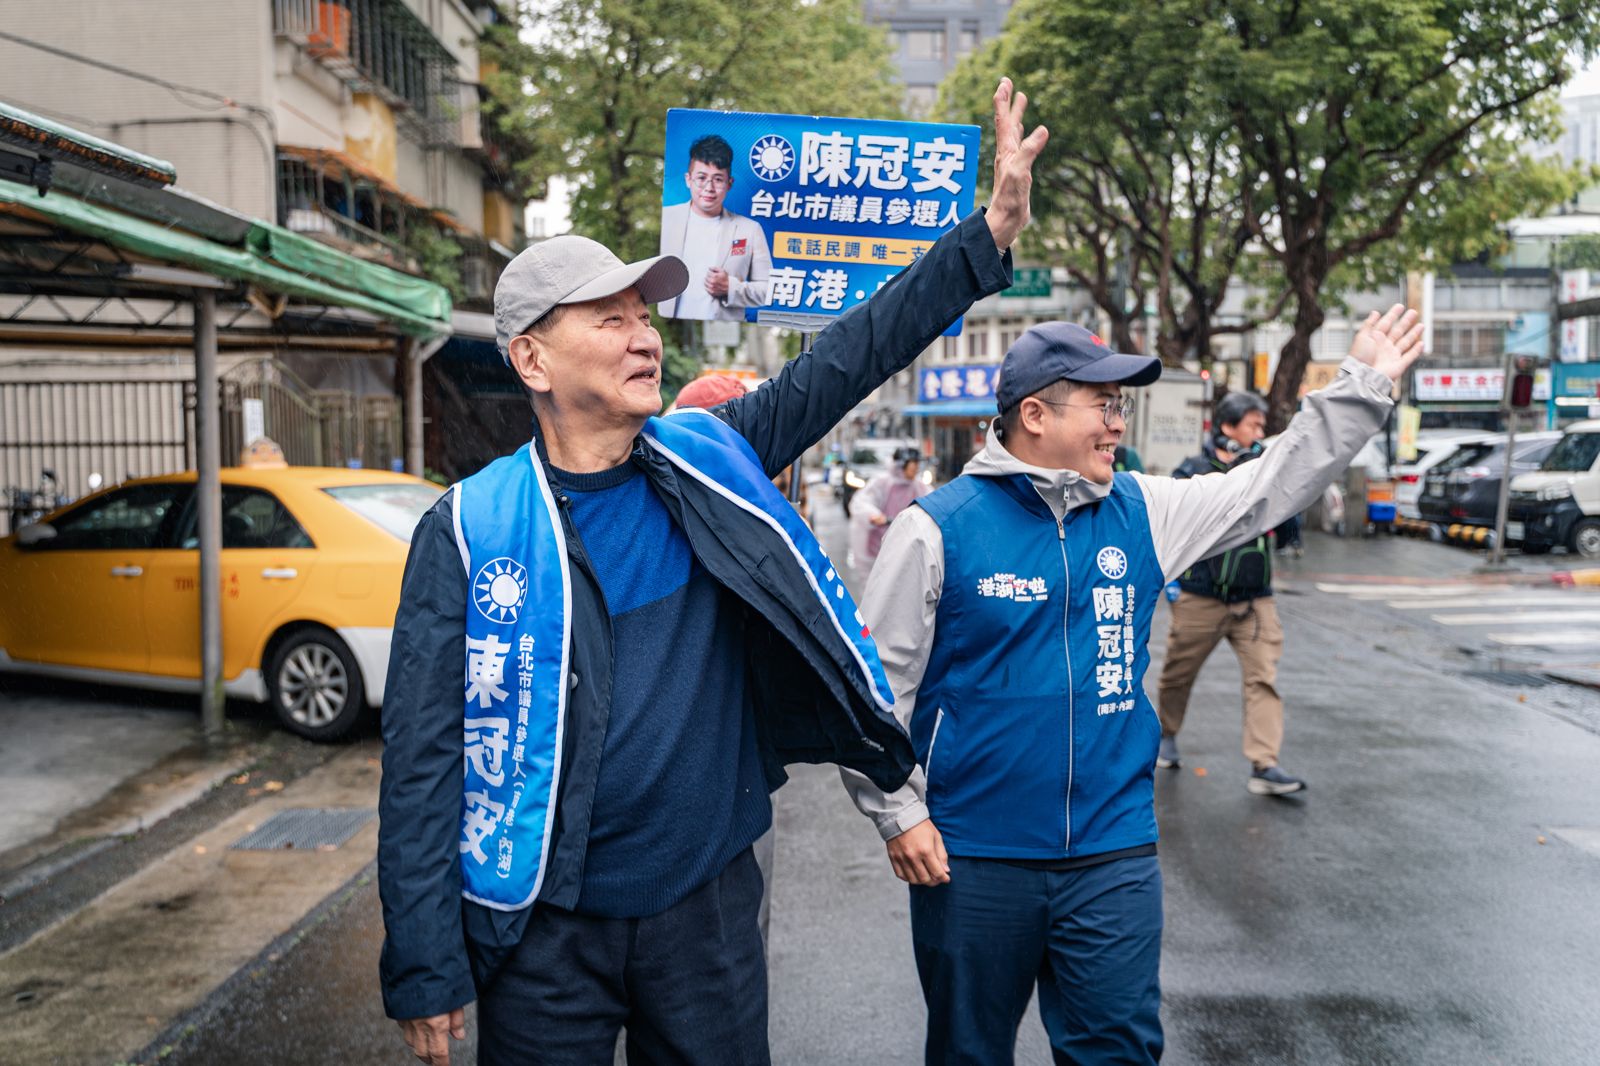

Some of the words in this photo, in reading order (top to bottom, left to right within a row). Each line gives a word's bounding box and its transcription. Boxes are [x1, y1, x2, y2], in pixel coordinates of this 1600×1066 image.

[800, 131, 966, 195] 陳冠安
[749, 189, 961, 228] 台北市議員參選人
[786, 237, 861, 258] 電話民調
[764, 266, 895, 310] 南港・
[1092, 585, 1125, 698] 陳冠安
